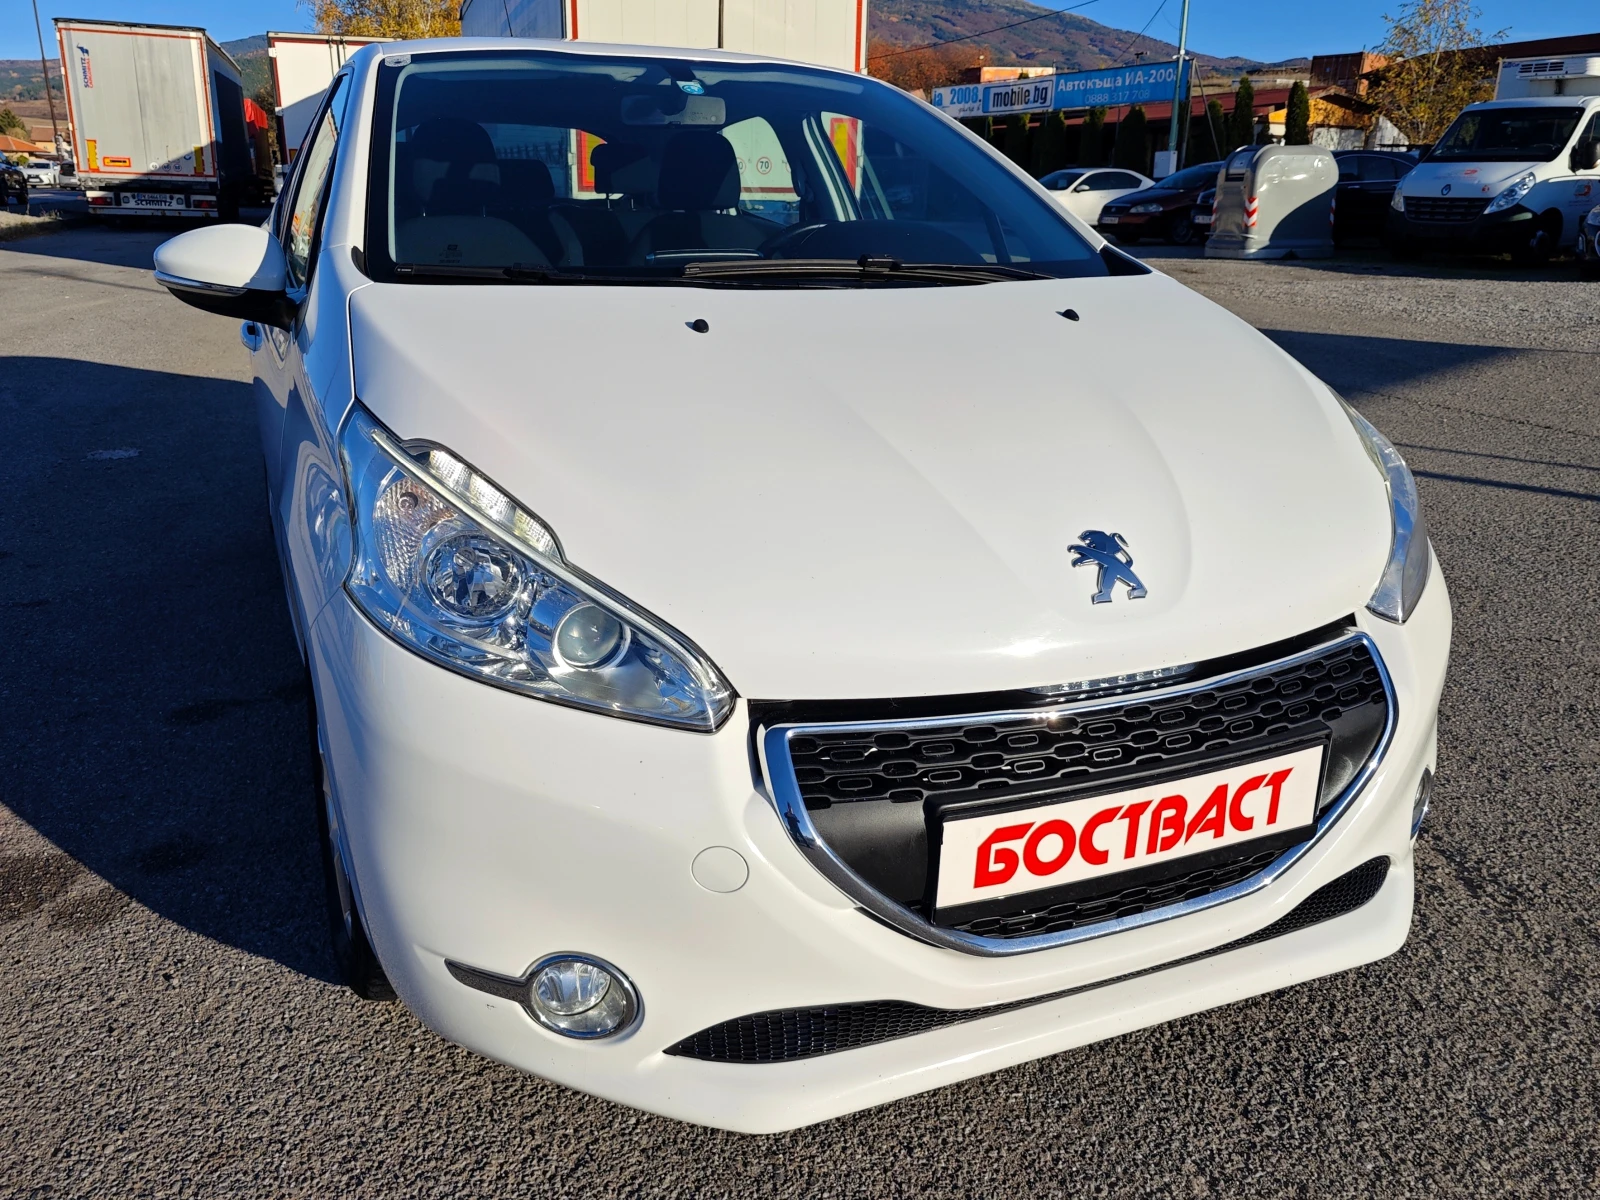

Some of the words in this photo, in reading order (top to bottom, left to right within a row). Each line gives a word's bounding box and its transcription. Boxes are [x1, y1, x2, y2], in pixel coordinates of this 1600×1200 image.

[81, 57, 89, 88] SCHMITZ
[1058, 76, 1122, 92] Автокъща
[992, 85, 1048, 108] mobile.bg
[1085, 93, 1109, 105] 0888
[1112, 91, 1129, 102] 317
[760, 161, 770, 170] 70
[134, 199, 173, 207] SCHMITZ
[973, 767, 1294, 889] БОСТВАСТ
